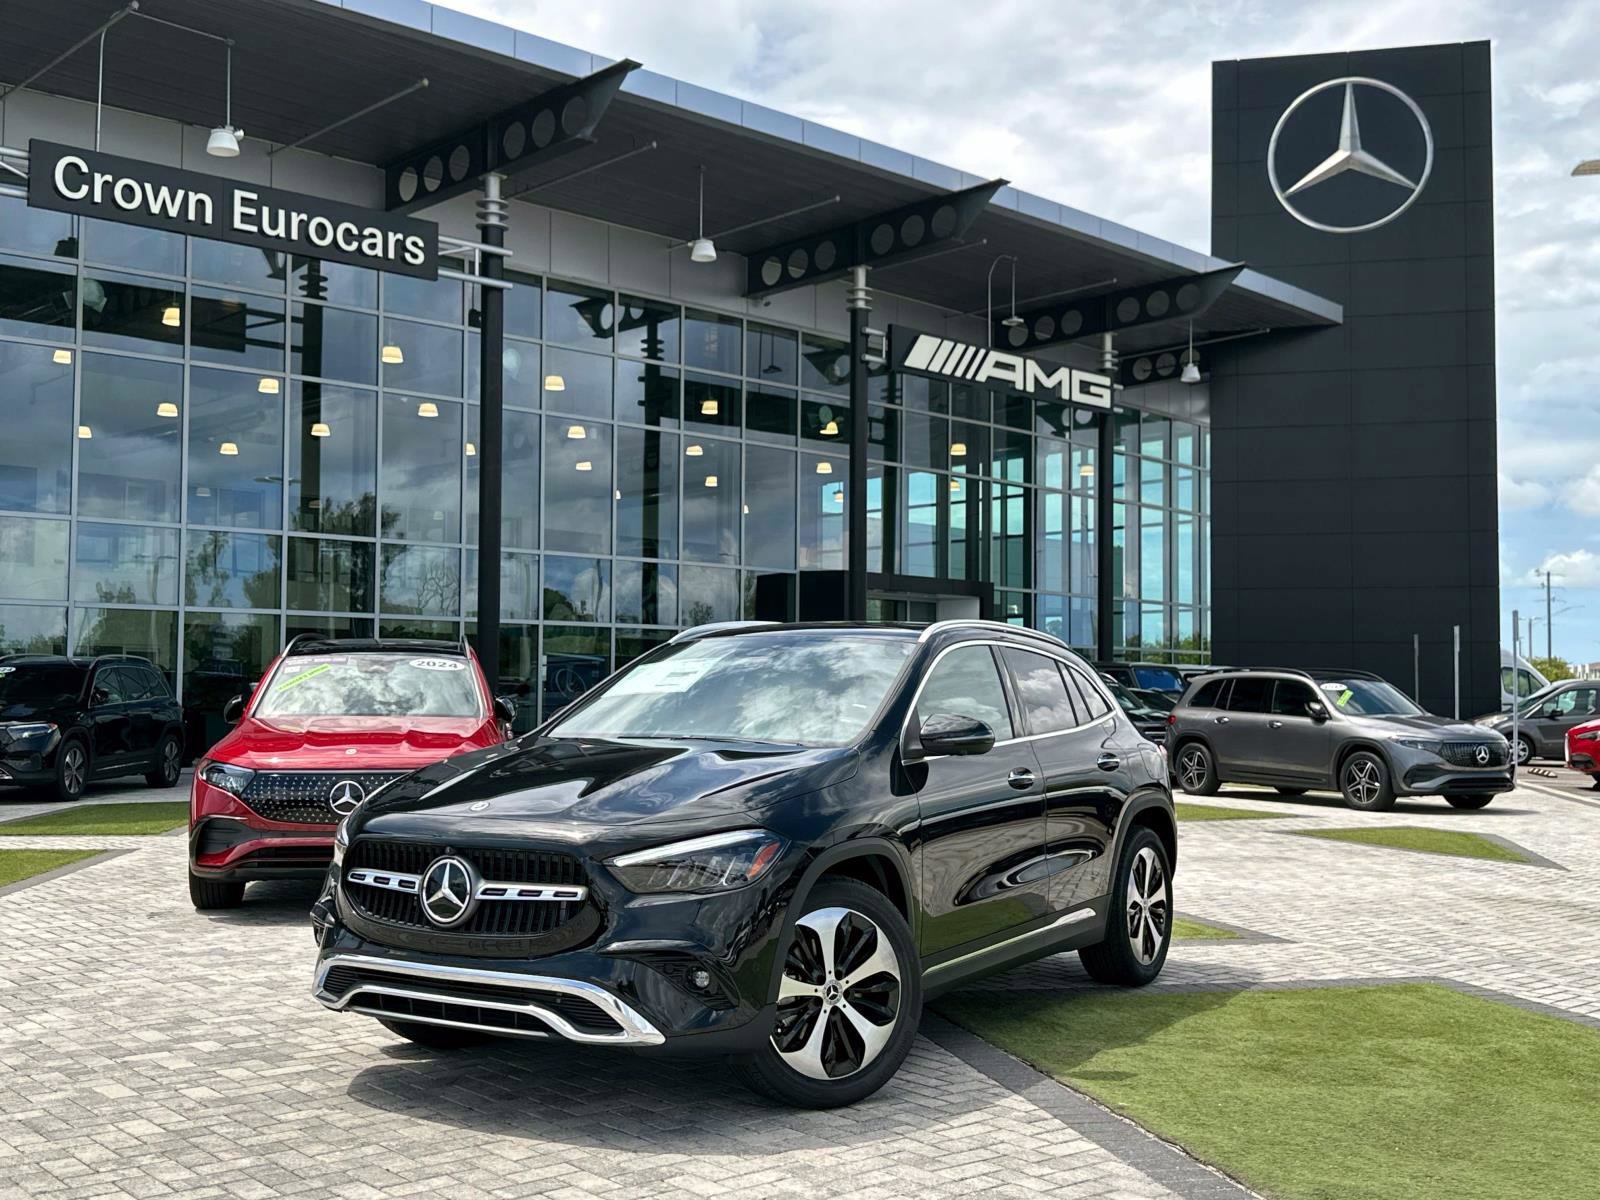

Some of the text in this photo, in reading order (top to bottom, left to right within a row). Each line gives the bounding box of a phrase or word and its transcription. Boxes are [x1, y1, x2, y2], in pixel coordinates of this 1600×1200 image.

[53, 155, 426, 266] Crown Eurocars
[975, 350, 1111, 409] AMG
[416, 660, 459, 669] 2024
